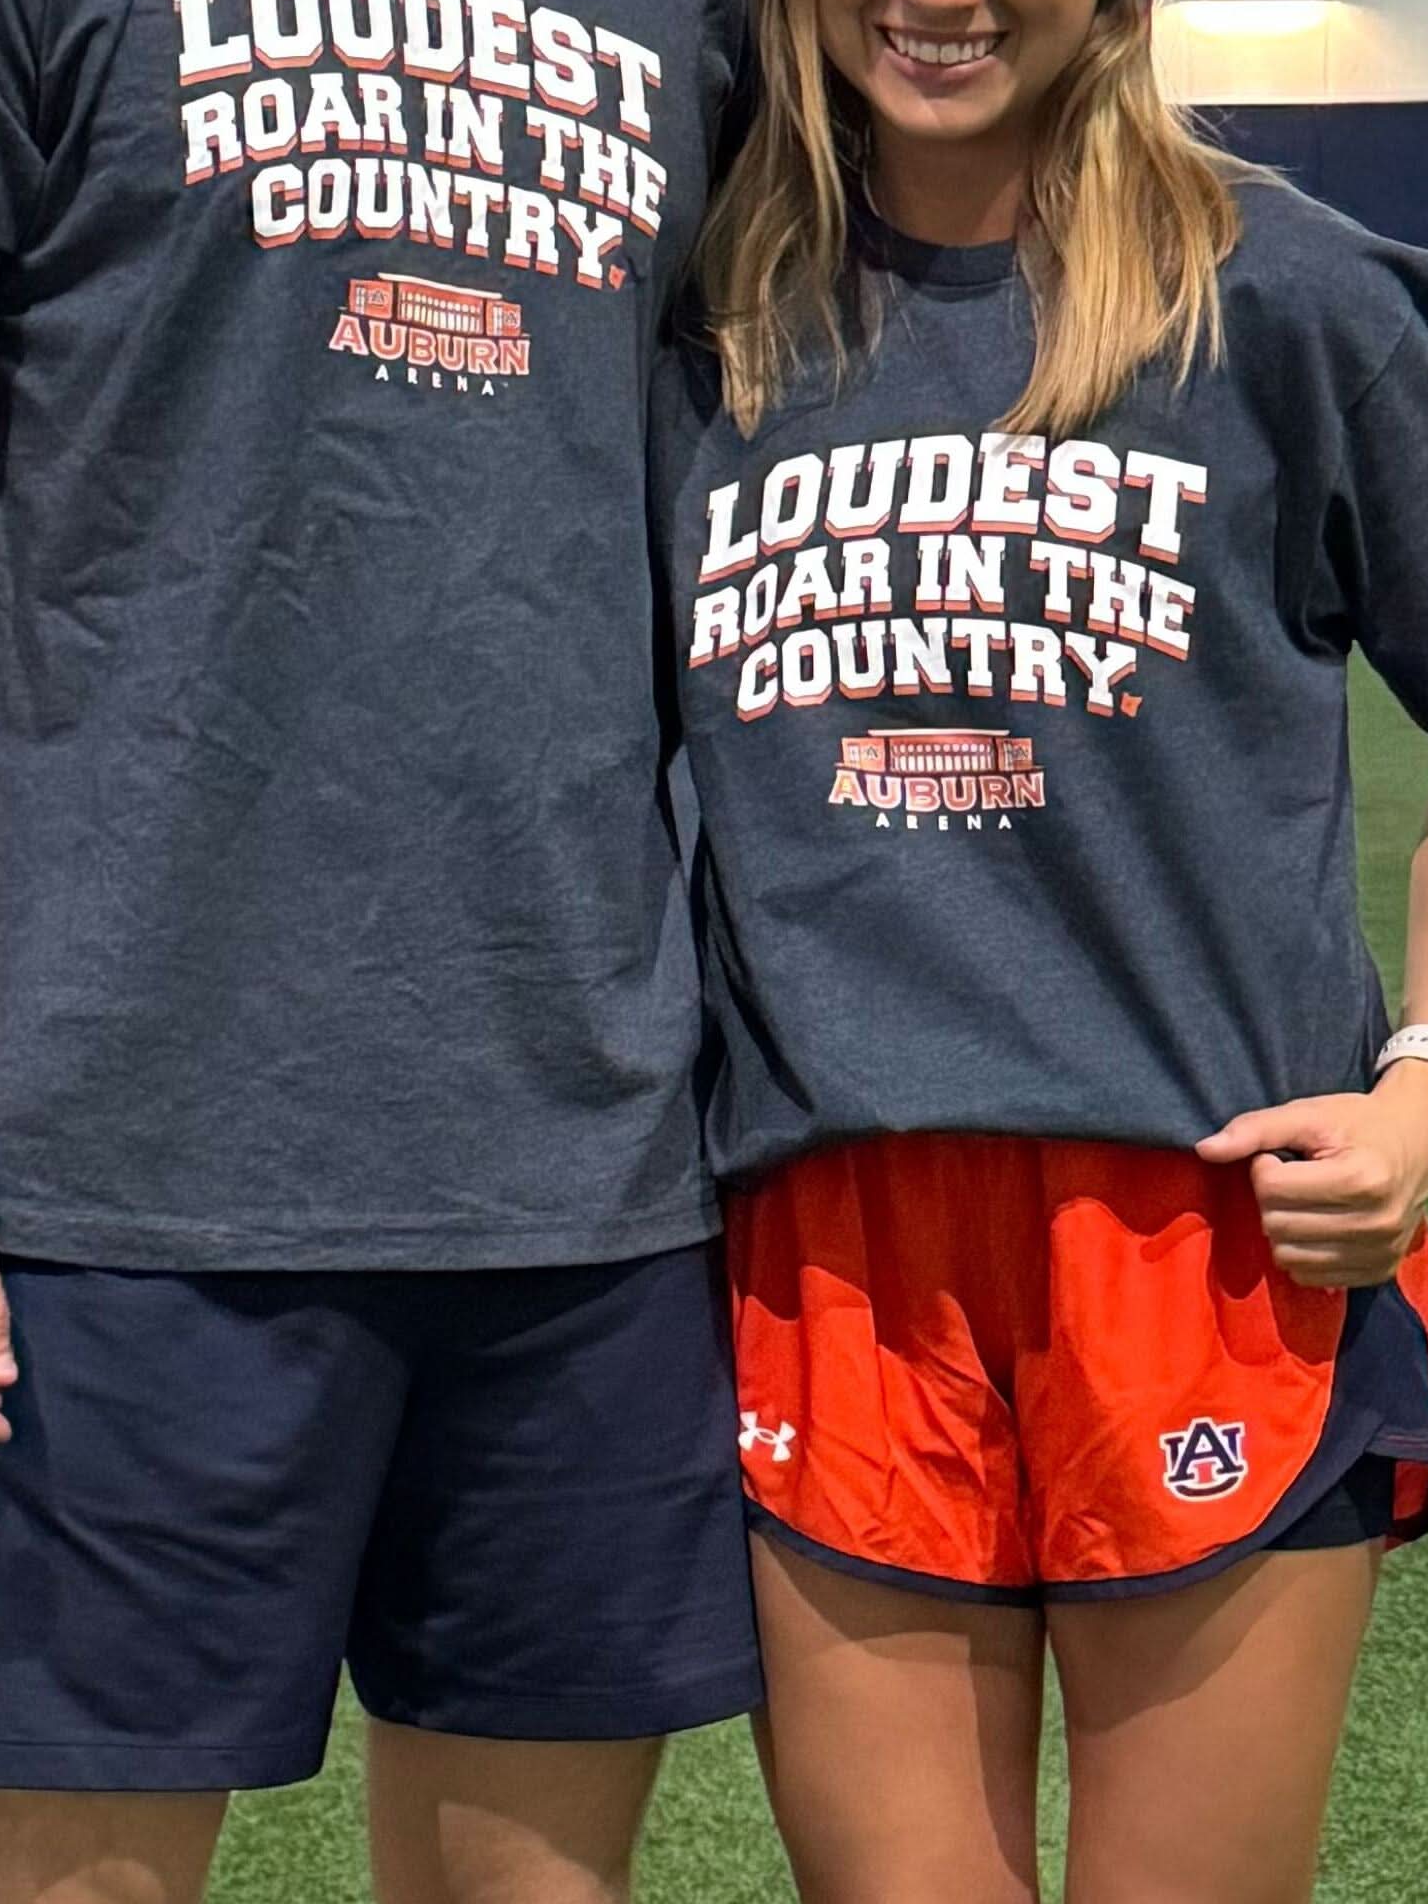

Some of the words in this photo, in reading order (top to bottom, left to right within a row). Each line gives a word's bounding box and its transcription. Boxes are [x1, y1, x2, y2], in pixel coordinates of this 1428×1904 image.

[180, 72, 408, 186] ROAR
[423, 82, 504, 175] IN
[525, 104, 668, 240] THE
[250, 157, 628, 291] COUNTRY.
[329, 313, 531, 376] AUBURN
[374, 363, 495, 397] ARENA
[697, 432, 1208, 585] LOUDEST
[688, 537, 893, 669] ROAR
[915, 535, 1006, 613] IN
[1029, 540, 1197, 662] THE
[735, 616, 1144, 723] COUNTRY.
[828, 769, 1046, 813] AUBURN
[875, 811, 1013, 831] ARENA
